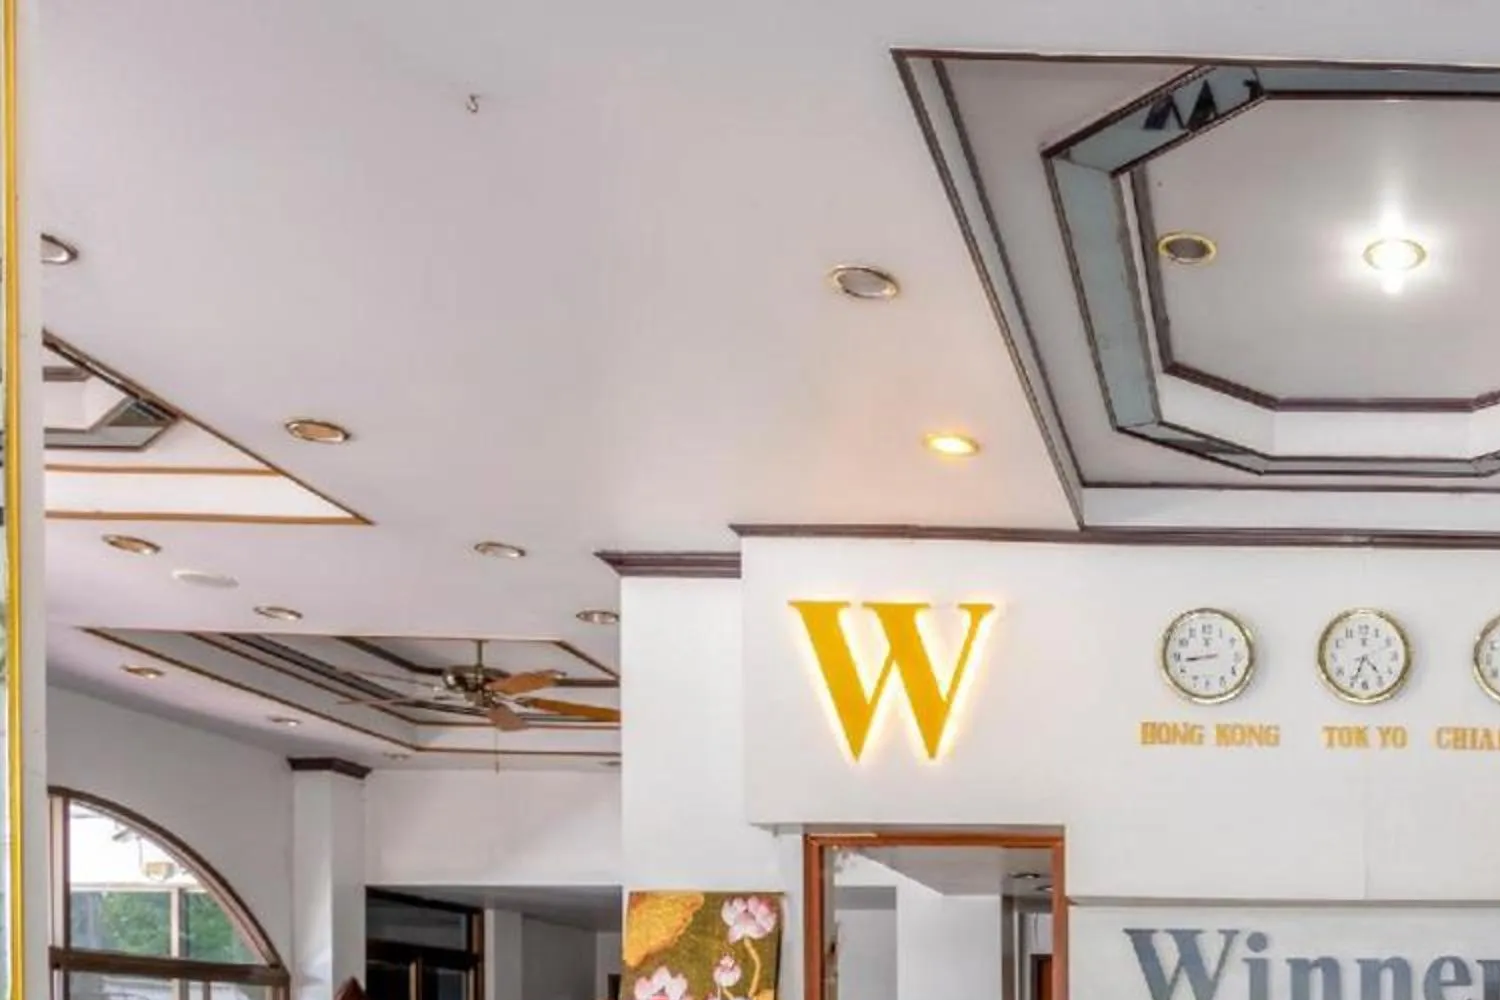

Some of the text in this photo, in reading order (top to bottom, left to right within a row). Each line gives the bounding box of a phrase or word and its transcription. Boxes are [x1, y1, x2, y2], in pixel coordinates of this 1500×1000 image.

[787, 600, 995, 762] W
[1140, 722, 1280, 747] HONG KONG
